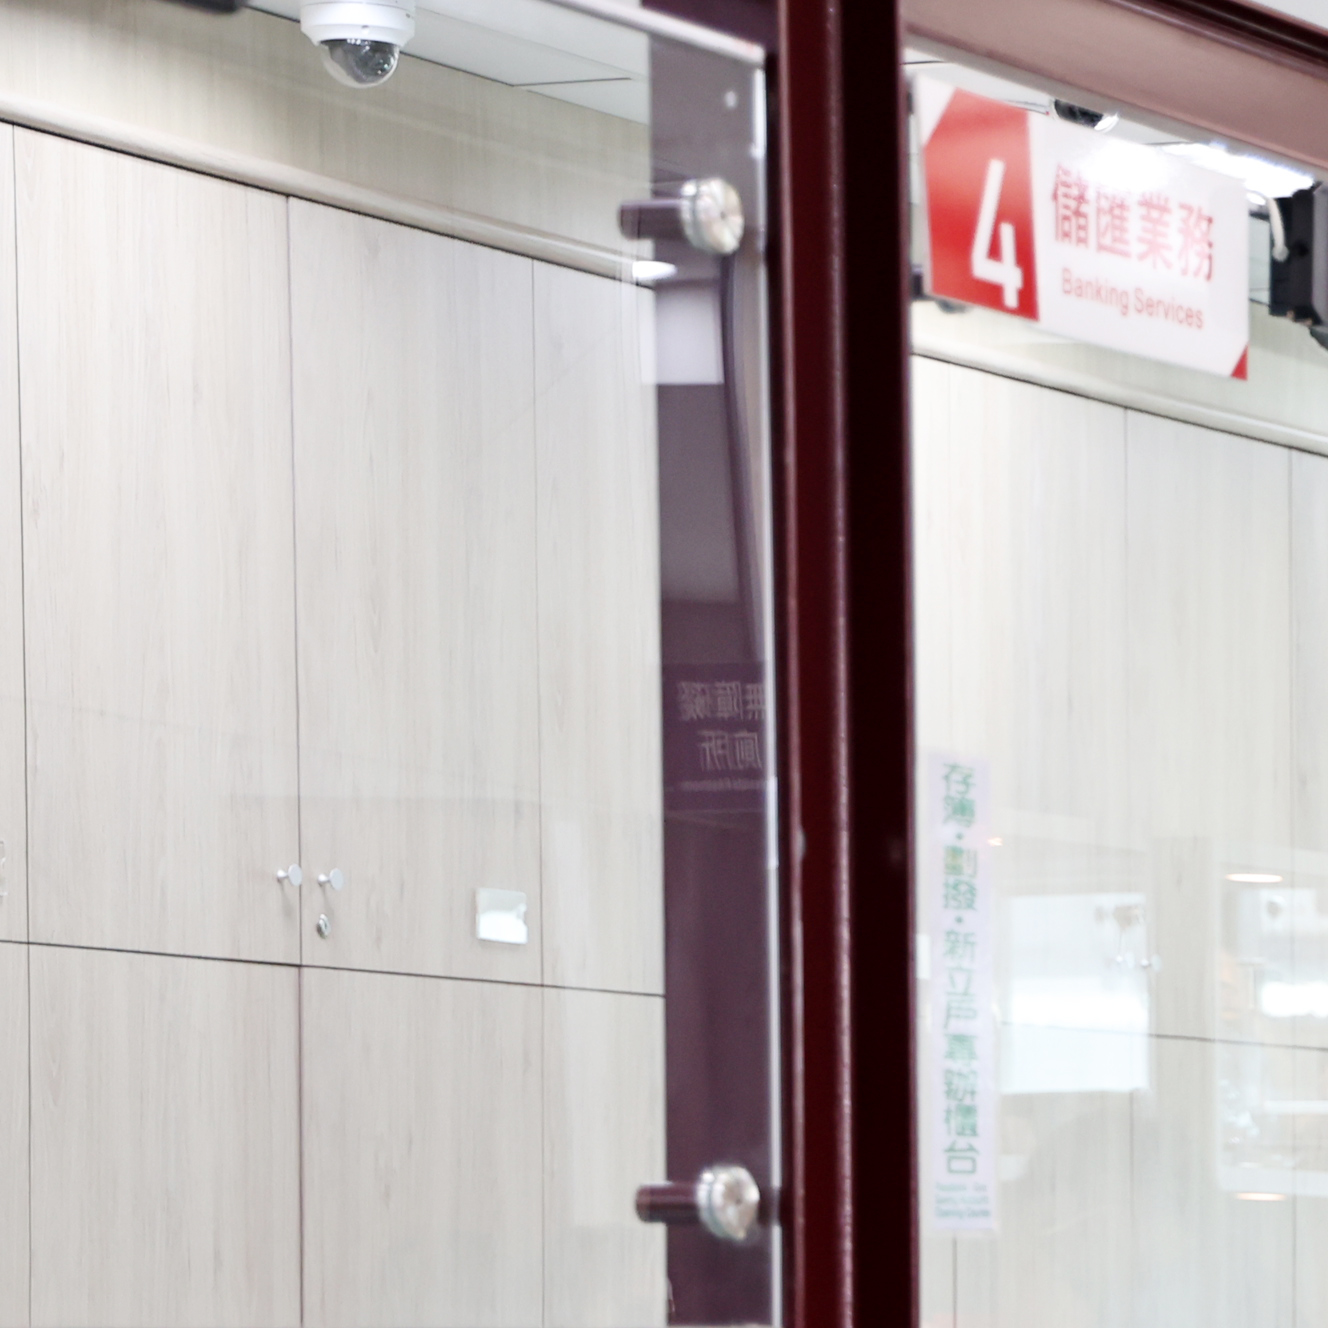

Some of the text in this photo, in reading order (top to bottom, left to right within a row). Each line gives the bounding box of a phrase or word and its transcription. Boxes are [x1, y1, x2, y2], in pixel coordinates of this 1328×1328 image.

[971, 158, 1022, 310] 4
[1052, 163, 1214, 282] 儲匯業務
[1061, 268, 1204, 331] Banking Services
